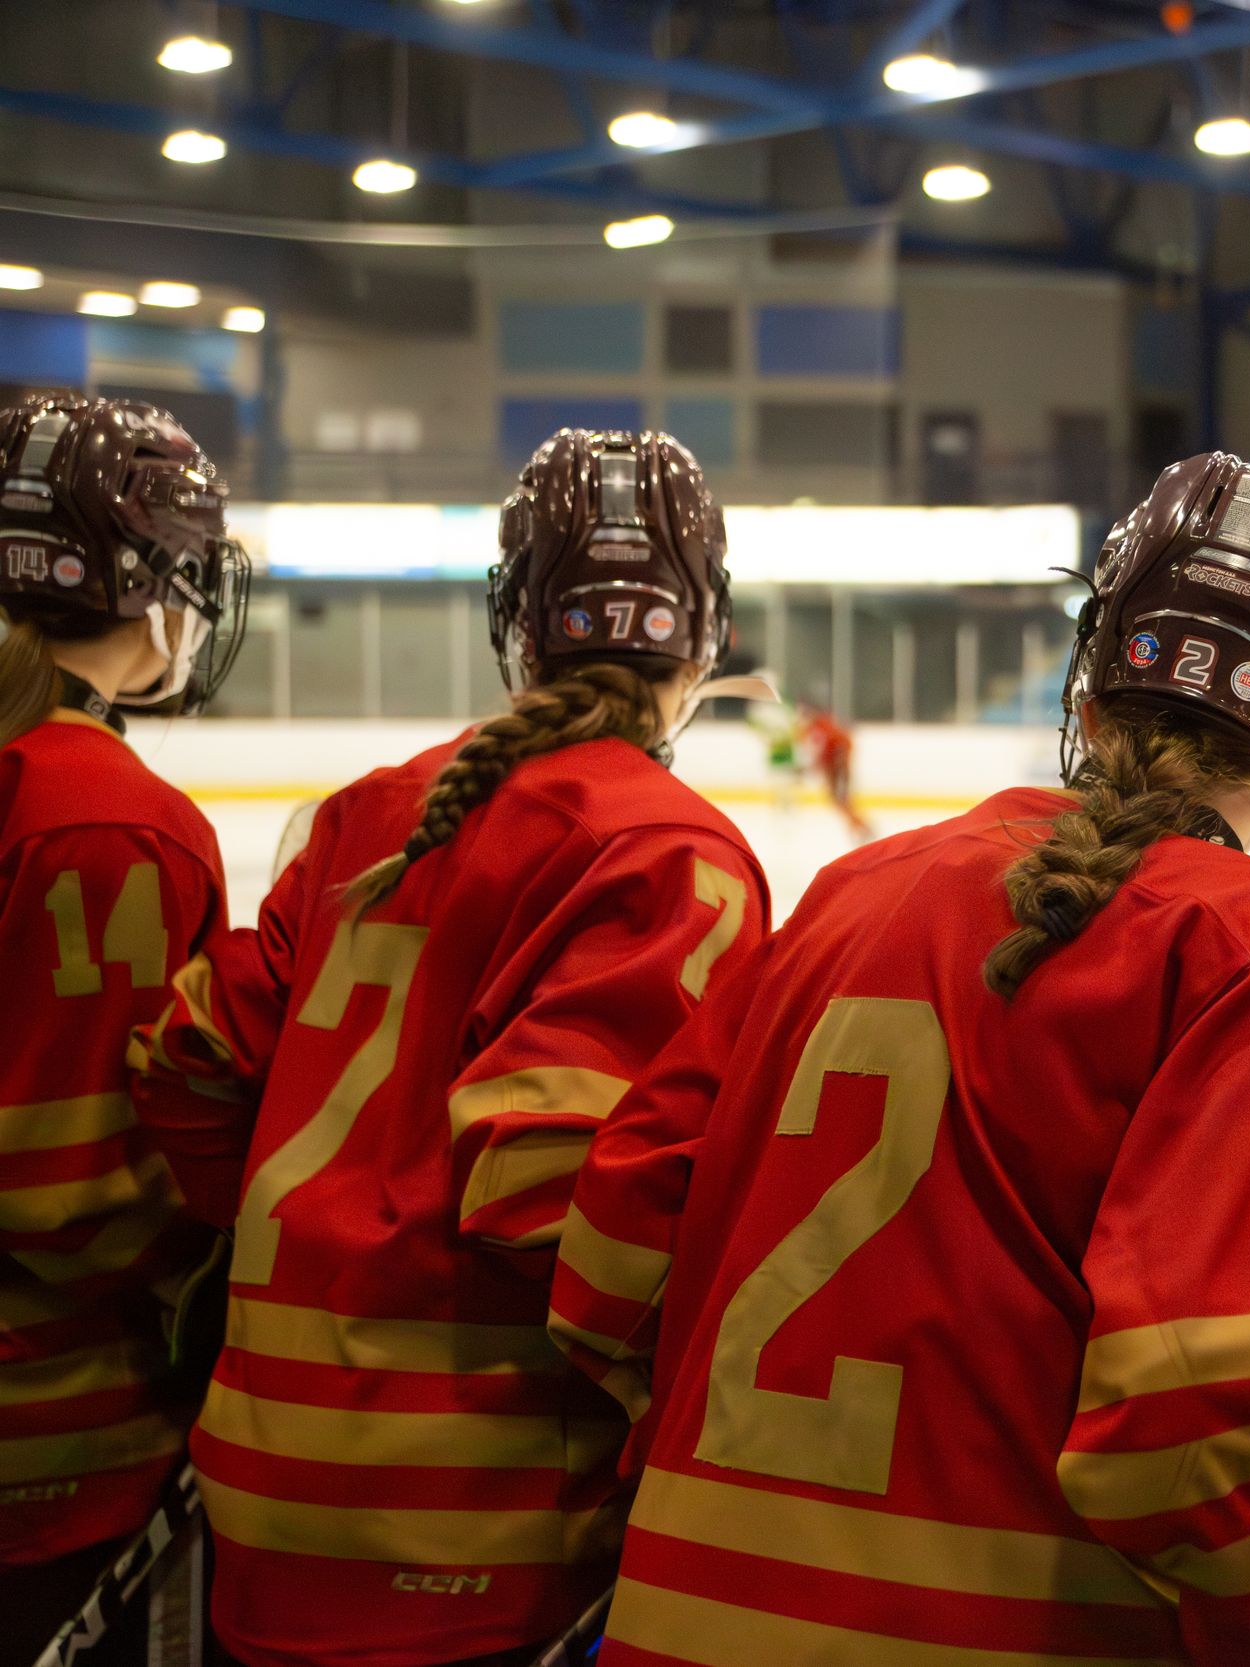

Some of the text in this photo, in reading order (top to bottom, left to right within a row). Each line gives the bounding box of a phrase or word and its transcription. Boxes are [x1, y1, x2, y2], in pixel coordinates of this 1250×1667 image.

[7, 544, 49, 582] 14
[605, 601, 637, 640] 7
[1172, 638, 1216, 686] 2
[45, 863, 169, 998] 14
[679, 857, 748, 1002] 7
[227, 921, 431, 1286] 7
[692, 997, 951, 1496] 2
[390, 1571, 492, 1595] CCM
